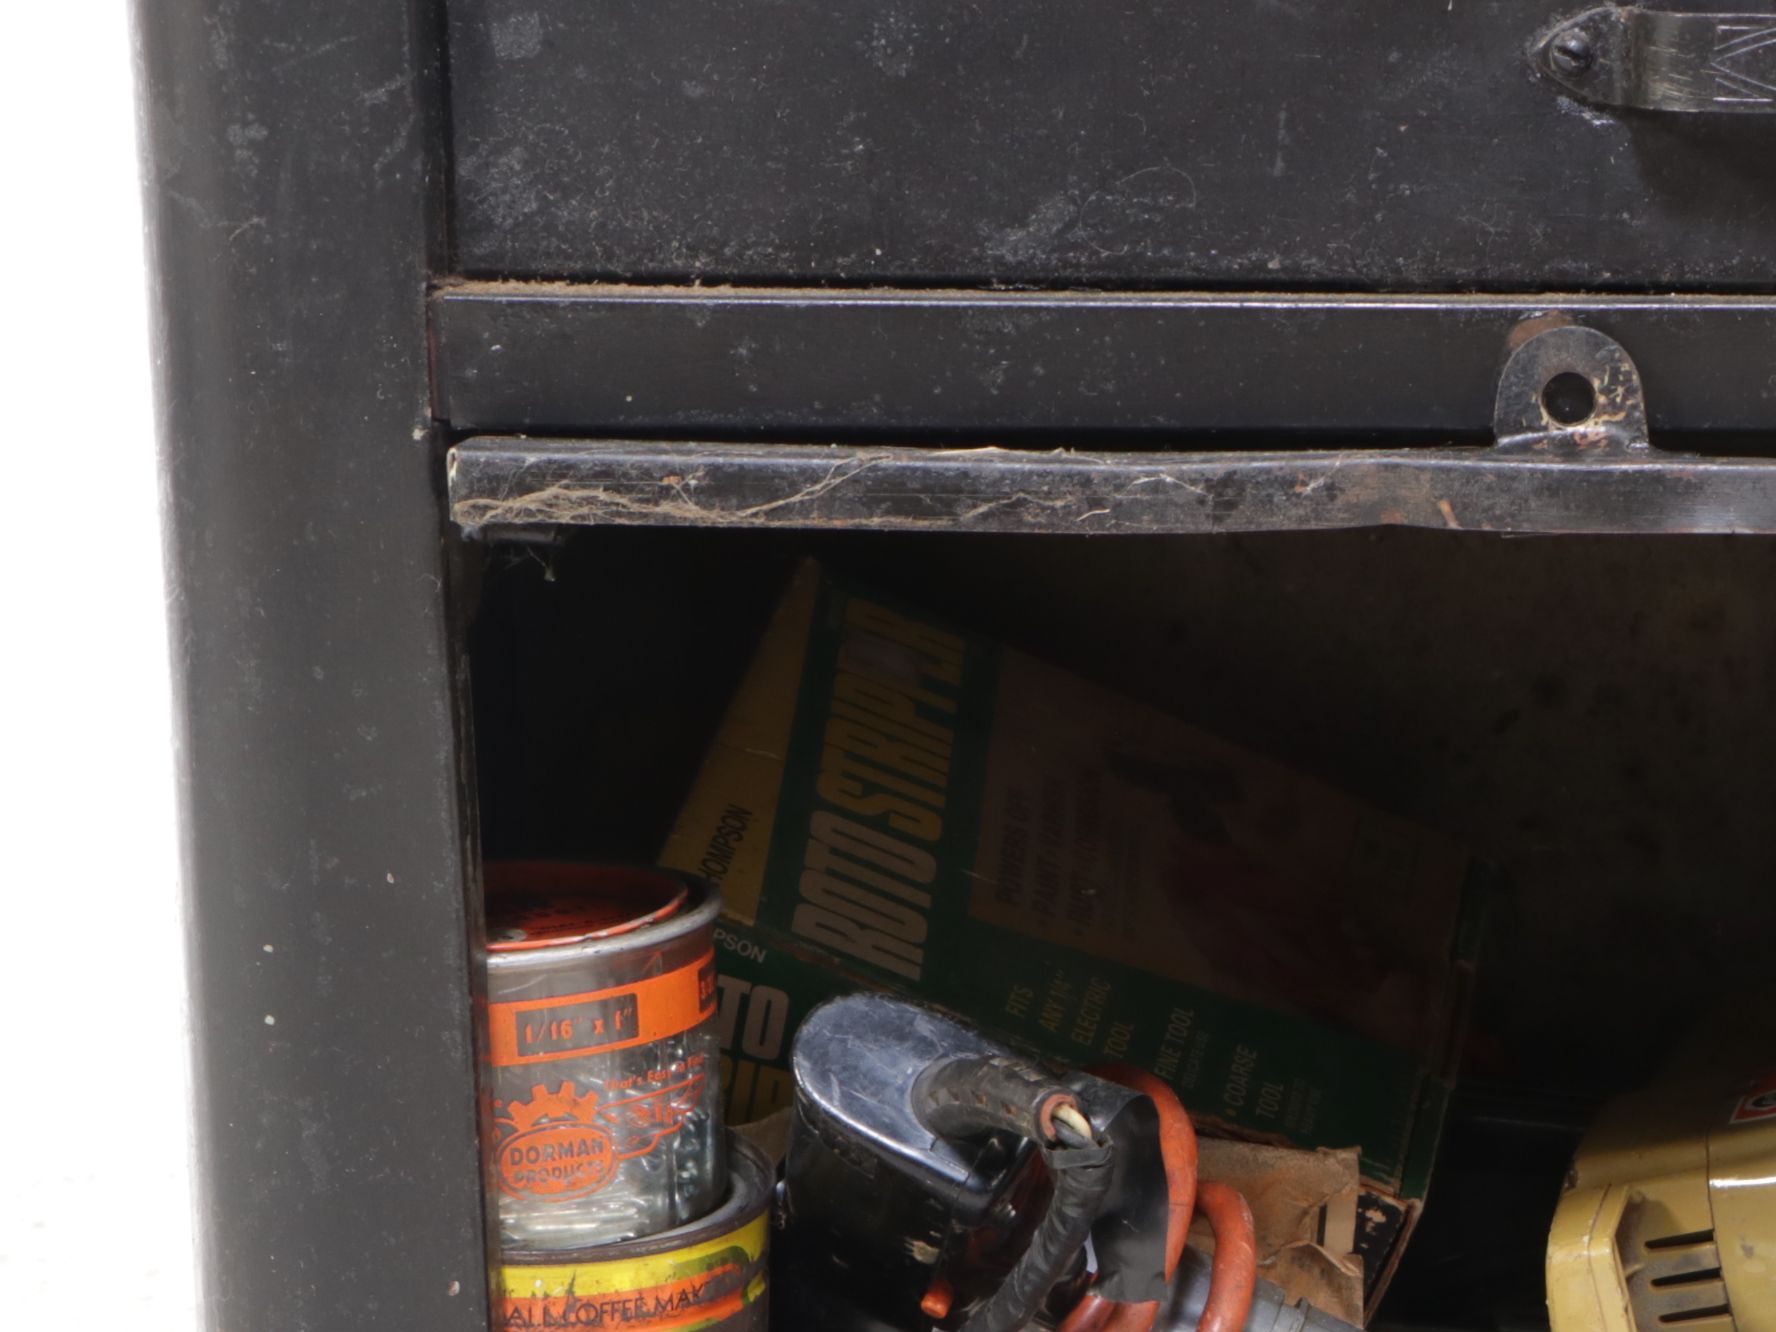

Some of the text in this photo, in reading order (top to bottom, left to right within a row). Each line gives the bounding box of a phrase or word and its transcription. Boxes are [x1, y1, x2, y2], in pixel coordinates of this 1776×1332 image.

[791, 809, 938, 982] ROTO
[1005, 983, 1034, 1019] FITS
[1038, 996, 1063, 1033] ANY
[1070, 976, 1112, 1048] ELECTRIC
[1103, 1021, 1135, 1060] TOOL
[1153, 1006, 1196, 1082] FINE TOOL
[1225, 1042, 1260, 1108] COARSE
[1255, 1081, 1286, 1121] TOOL
[509, 1136, 605, 1166] DORMAN
[655, 1280, 710, 1313] MAK
